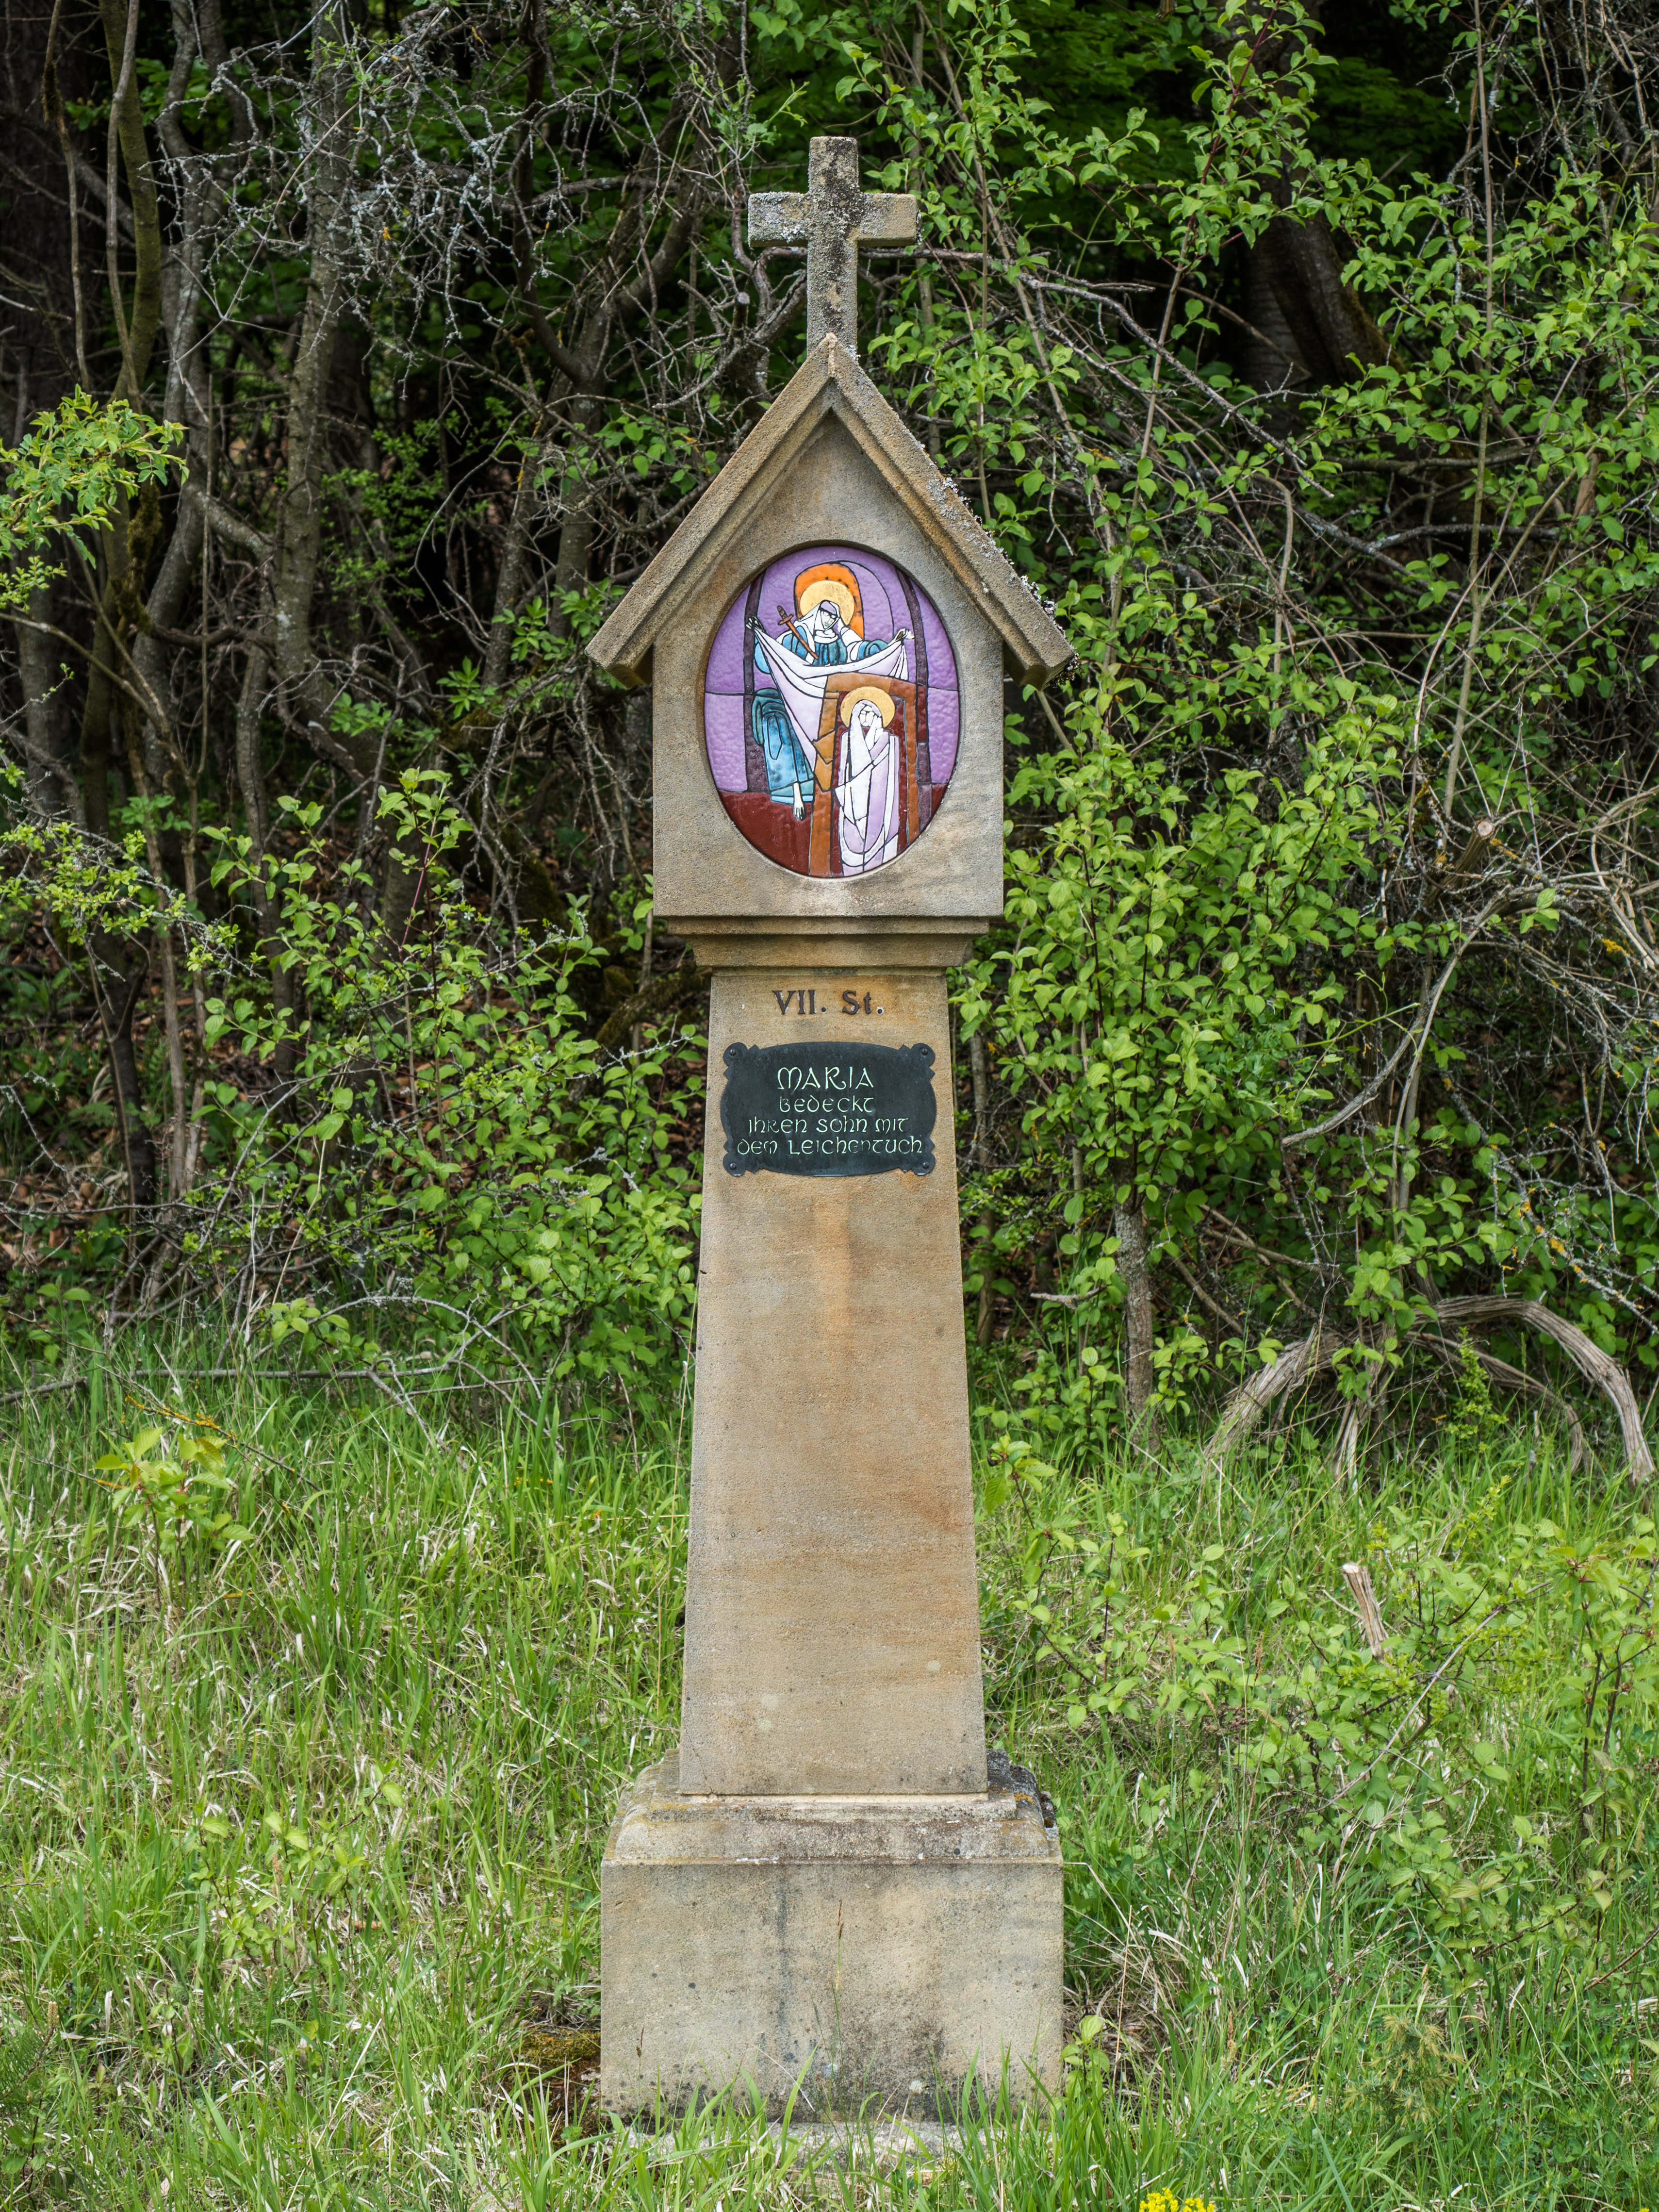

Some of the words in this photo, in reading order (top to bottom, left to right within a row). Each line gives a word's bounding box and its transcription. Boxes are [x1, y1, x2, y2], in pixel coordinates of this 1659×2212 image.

[772, 990, 826, 1015] VII.
[841, 990, 884, 1015] St.
[777, 1066, 874, 1090] MARIA
[779, 1095, 874, 1113] BEDECKT
[748, 1116, 808, 1134] IHREN
[816, 1115, 867, 1133] SOHN
[875, 1117, 909, 1133] MIT
[737, 1138, 777, 1156] DEM
[788, 1135, 922, 1156] LEICHENTUCH
